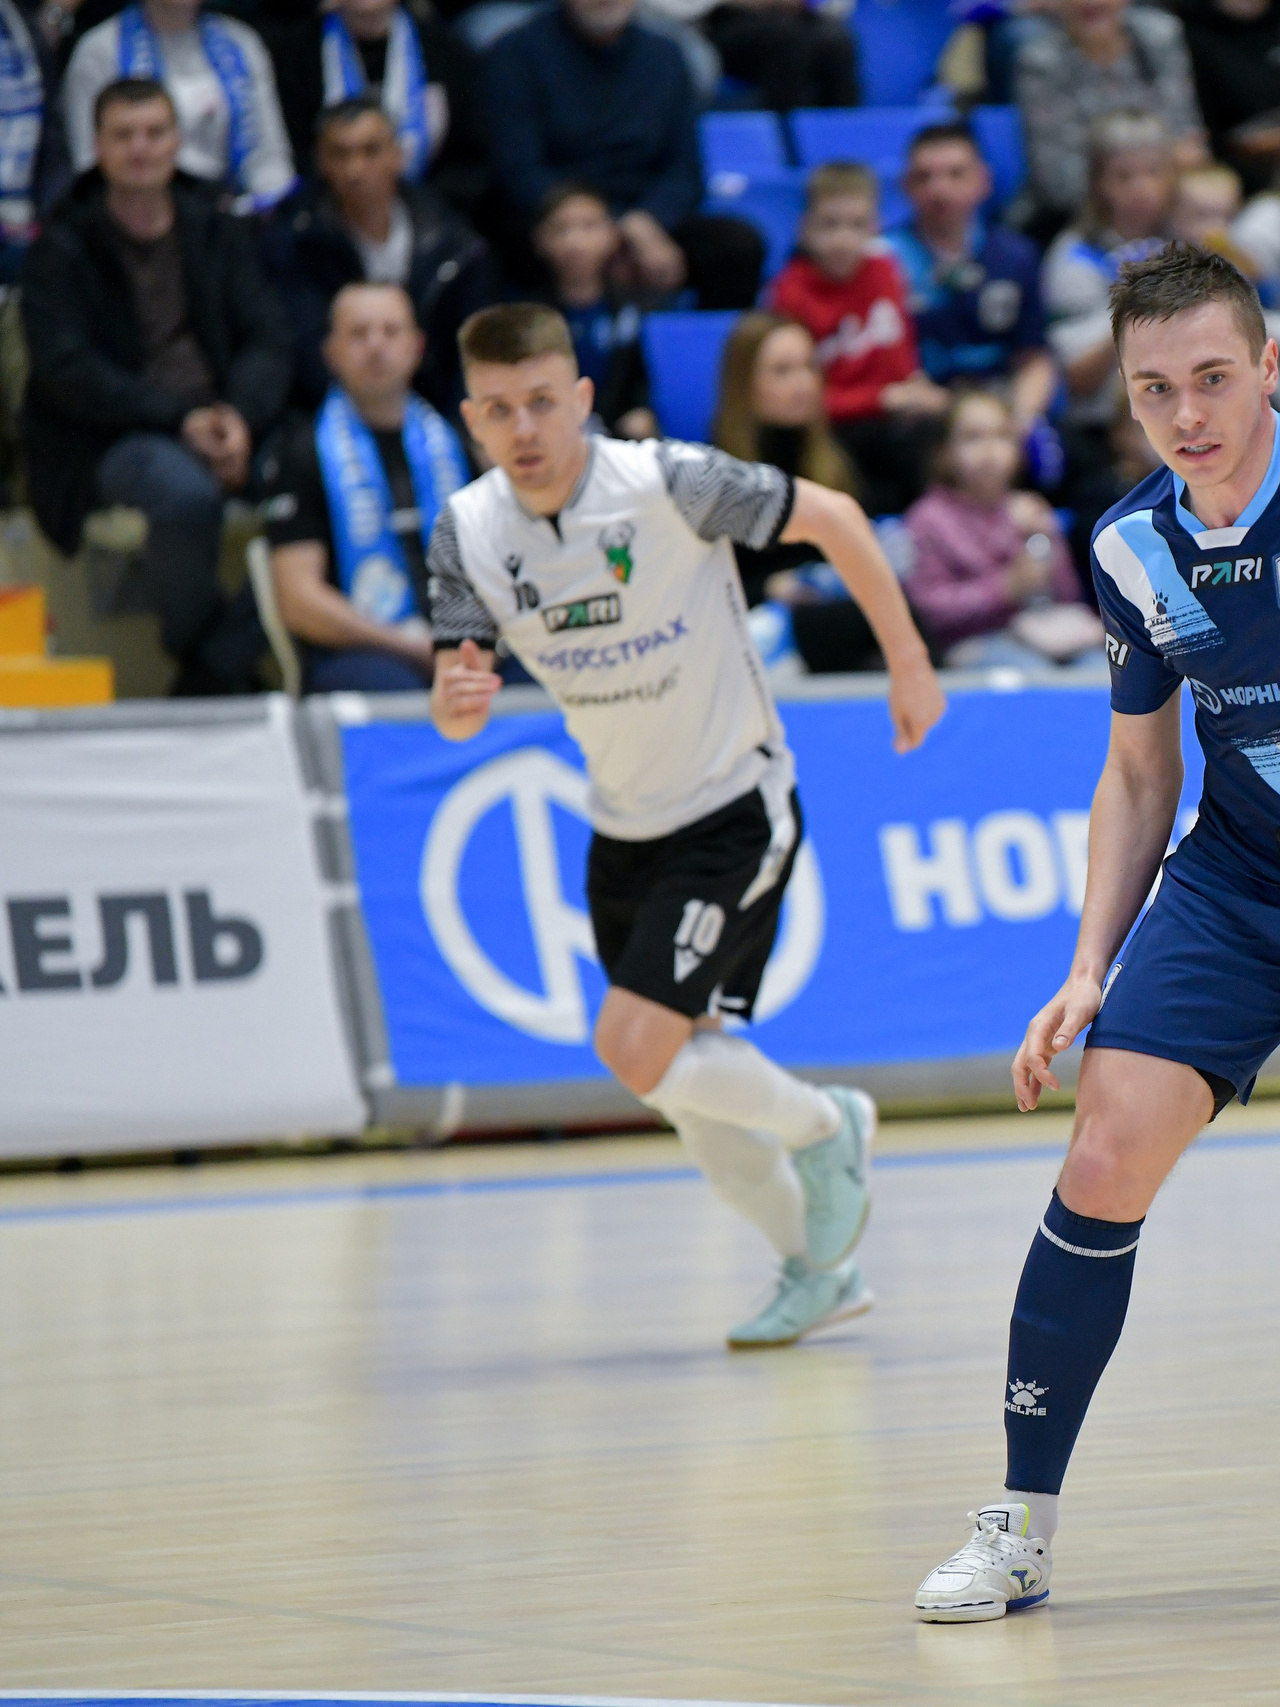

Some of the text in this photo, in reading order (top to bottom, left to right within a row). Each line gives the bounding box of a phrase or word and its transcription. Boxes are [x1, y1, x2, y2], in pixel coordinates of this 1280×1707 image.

[1191, 556, 1263, 589] PARI
[1105, 632, 1129, 667] RI
[0, 885, 265, 994] ЕЛЬ
[674, 898, 725, 956] 10
[1004, 1400, 1047, 1416] KELME
